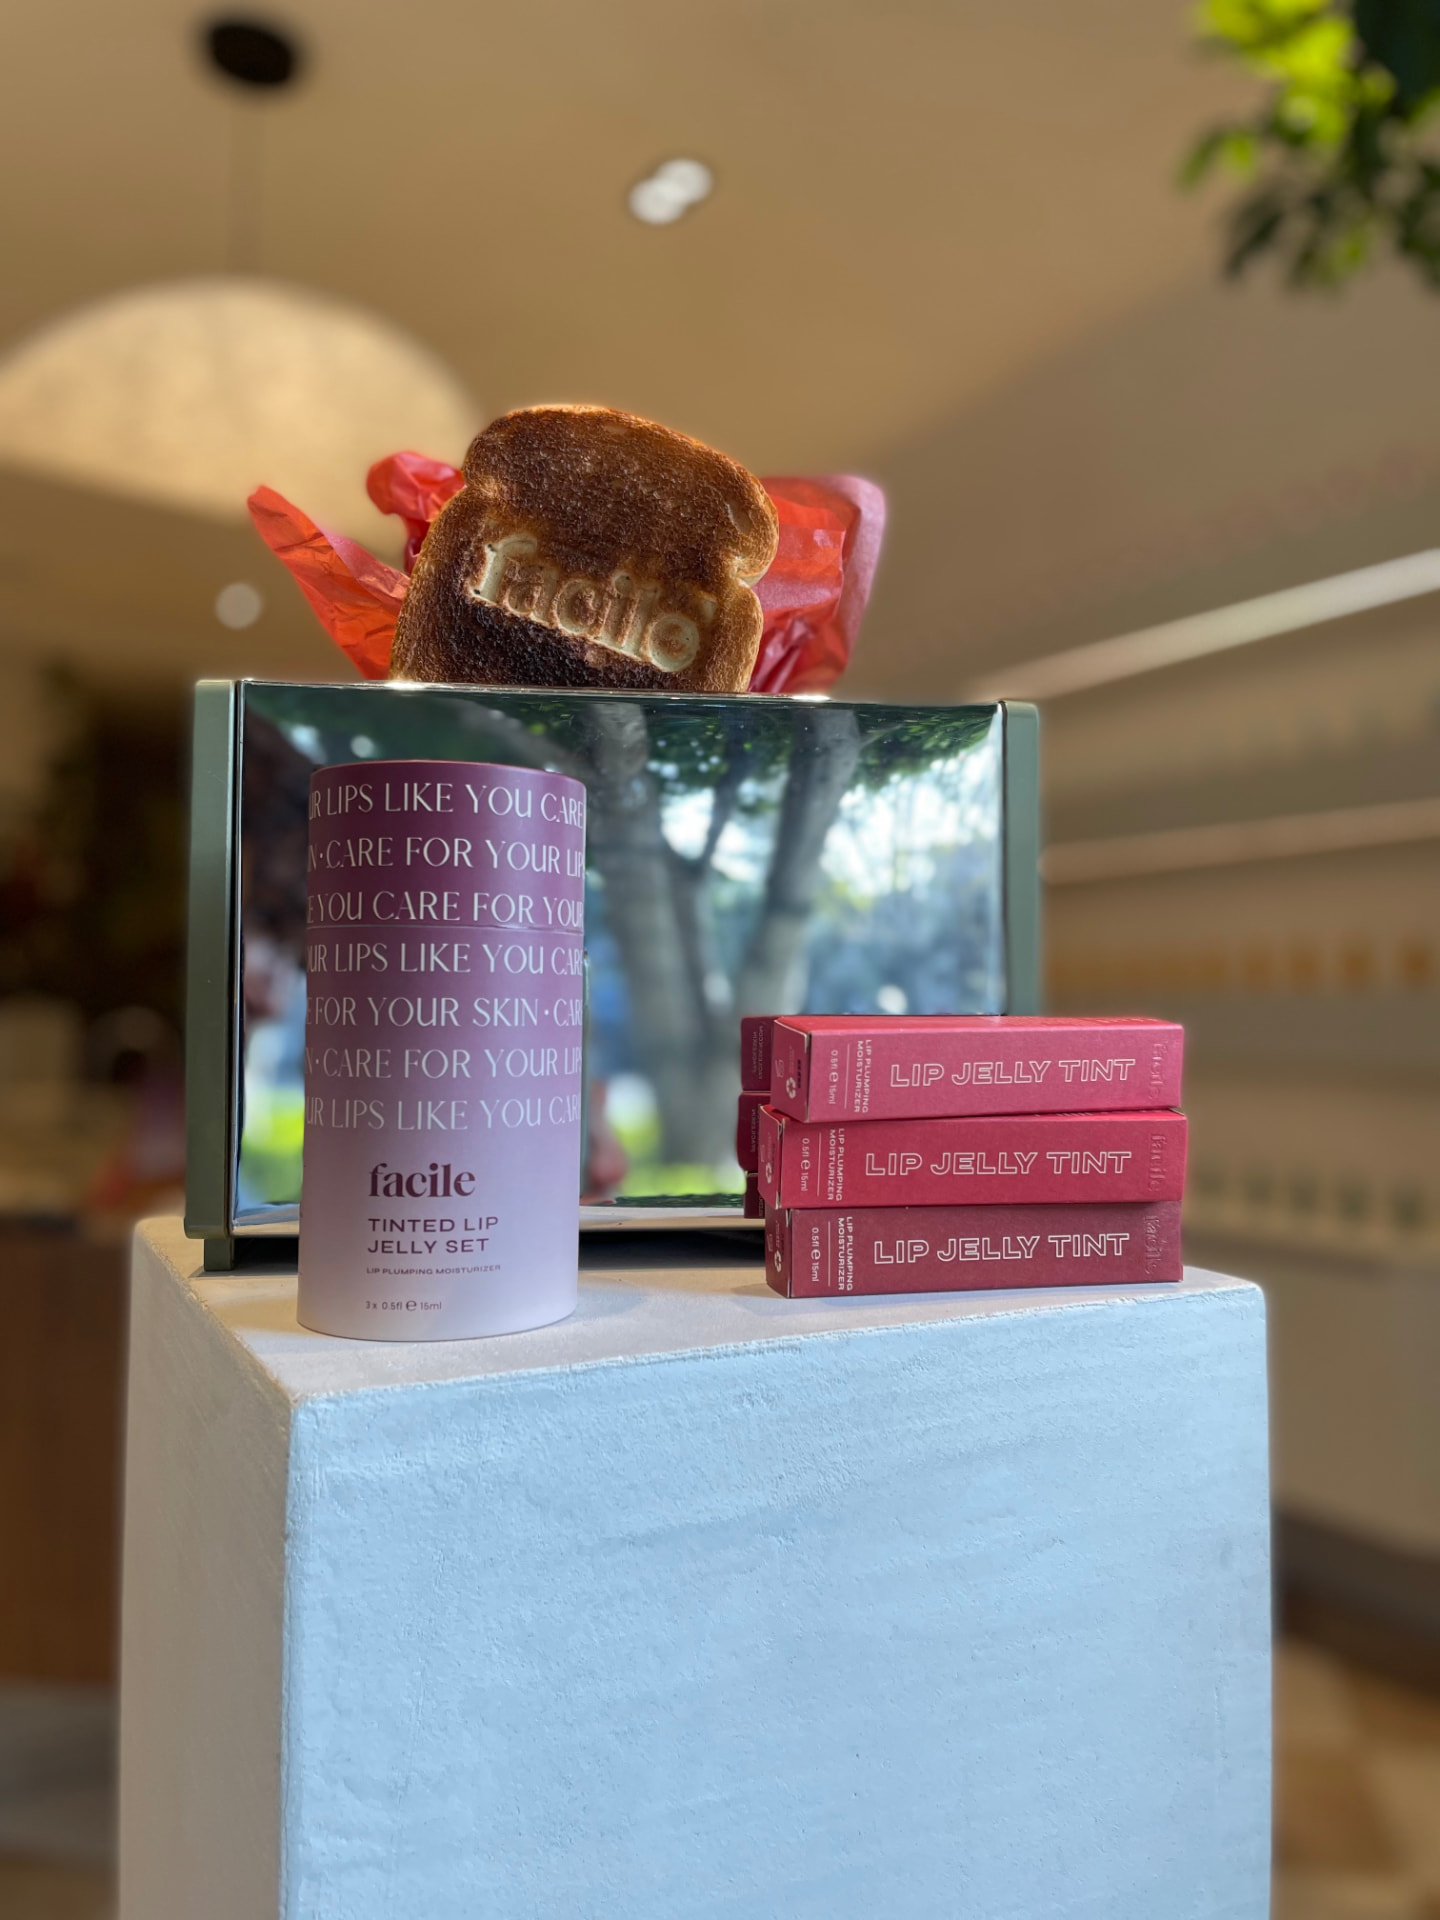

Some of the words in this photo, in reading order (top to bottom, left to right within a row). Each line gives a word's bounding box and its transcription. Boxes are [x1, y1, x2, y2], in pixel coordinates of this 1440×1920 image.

[327, 784, 373, 816] LIPS
[385, 783, 453, 812] LIKE
[465, 784, 532, 817] YOU
[540, 792, 584, 829] CARE
[406, 837, 472, 867] FOR
[485, 840, 560, 874] YOUR
[317, 891, 363, 921] YOU
[373, 890, 460, 921] CARE
[473, 892, 533, 923] FOR
[335, 943, 388, 972] LIPS
[400, 943, 471, 972] LIKE
[482, 945, 544, 974] YOU
[315, 997, 357, 1025] FOR
[368, 997, 461, 1027] YOUR
[404, 1049, 471, 1079] FOR
[484, 1048, 558, 1078] YOUR
[854, 1040, 863, 1114] MOISTURIZER
[890, 1063, 944, 1087] LIP
[952, 1061, 1050, 1085] JELLY
[1059, 1059, 1135, 1082] TINT
[862, 1058, 871, 1113] PLUMPING
[331, 1100, 384, 1130] LIPS
[397, 1100, 468, 1131] LIKE
[479, 1098, 541, 1128] YOU
[827, 1129, 836, 1201] MOISTURIZER
[836, 1147, 844, 1201] PLUMPING
[866, 1153, 922, 1175] LIP
[930, 1152, 1038, 1174] JELLY
[1047, 1152, 1131, 1174] TINT
[368, 1163, 476, 1198] facile
[368, 1218, 455, 1232] TINTED
[464, 1216, 499, 1231] LIP
[368, 1240, 437, 1254] JELLY
[445, 1238, 490, 1253] SET
[875, 1239, 929, 1264] LIP
[937, 1235, 1040, 1260] JELLY
[1049, 1234, 1129, 1257] TINT
[436, 1265, 501, 1274] MOISTURIZER
[420, 1301, 442, 1310] 15ml
